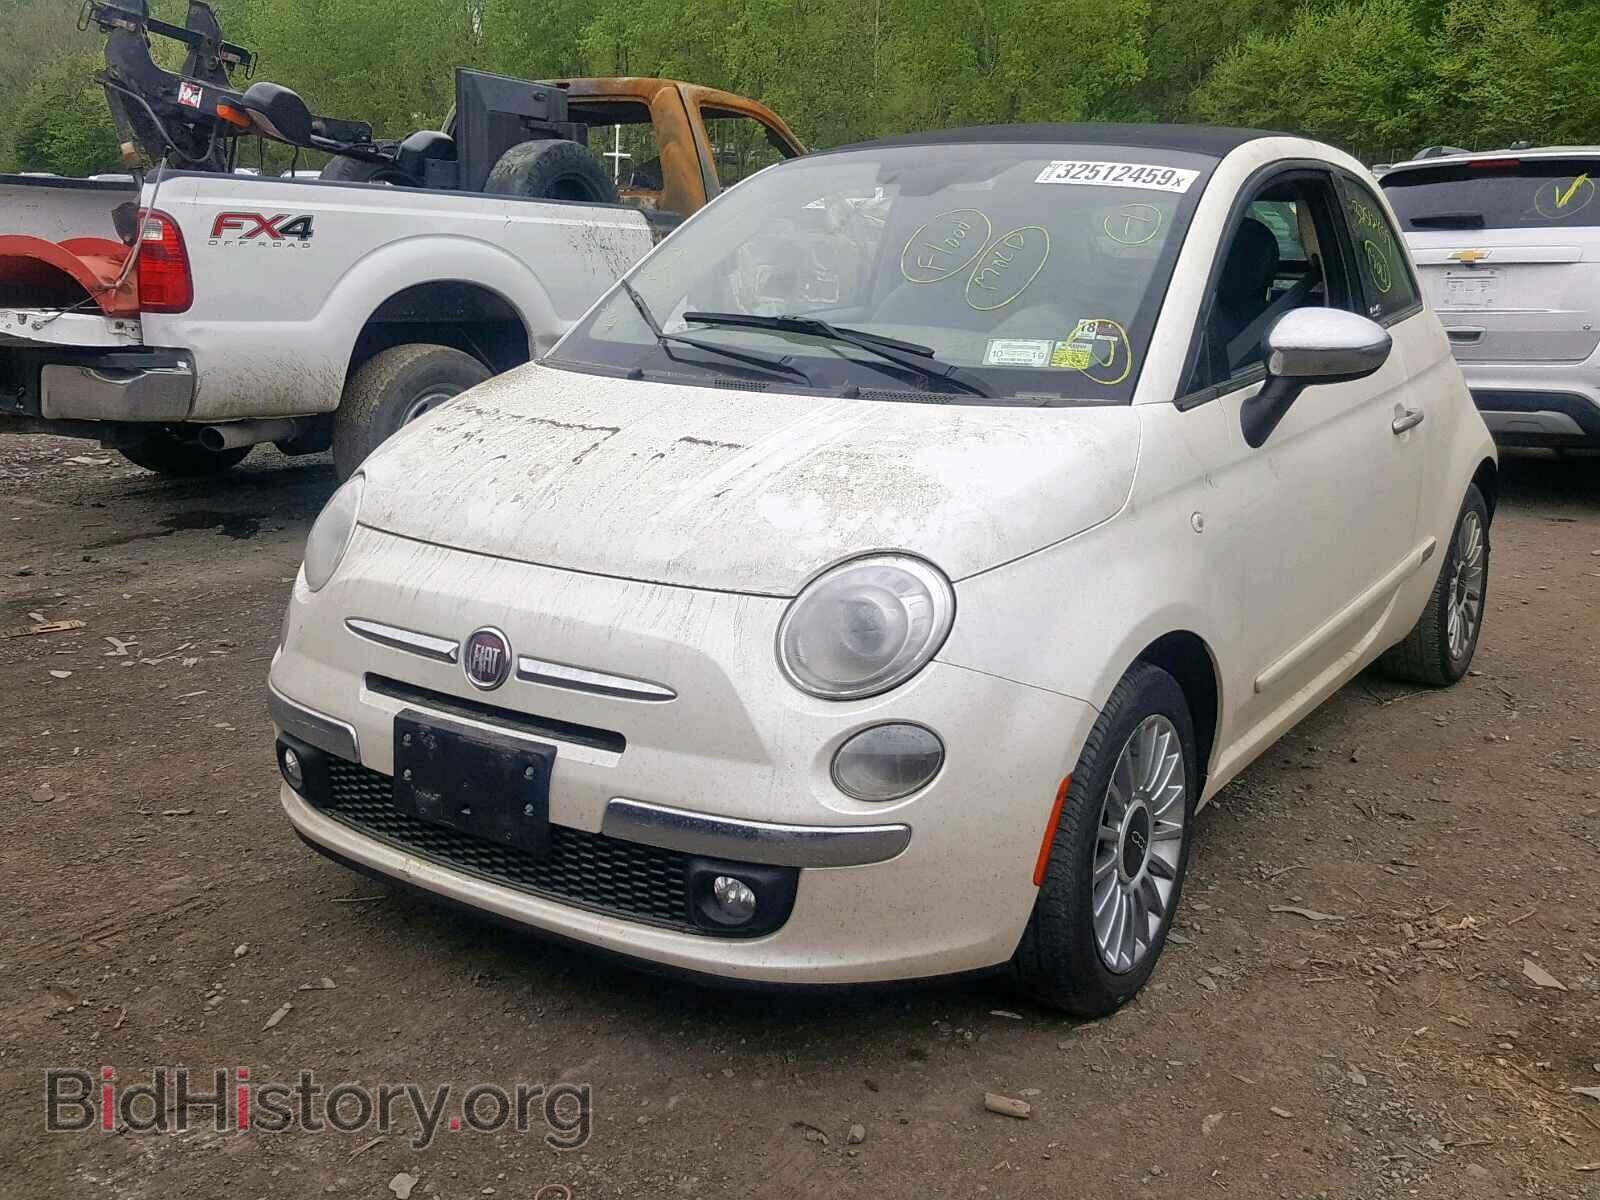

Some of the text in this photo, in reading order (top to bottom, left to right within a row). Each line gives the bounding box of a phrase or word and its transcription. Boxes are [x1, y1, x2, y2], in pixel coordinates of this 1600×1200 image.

[1056, 163, 1177, 186] 32512459
[210, 211, 314, 241] FX4
[258, 241, 311, 249] ROAD
[471, 643, 502, 675] FIAT
